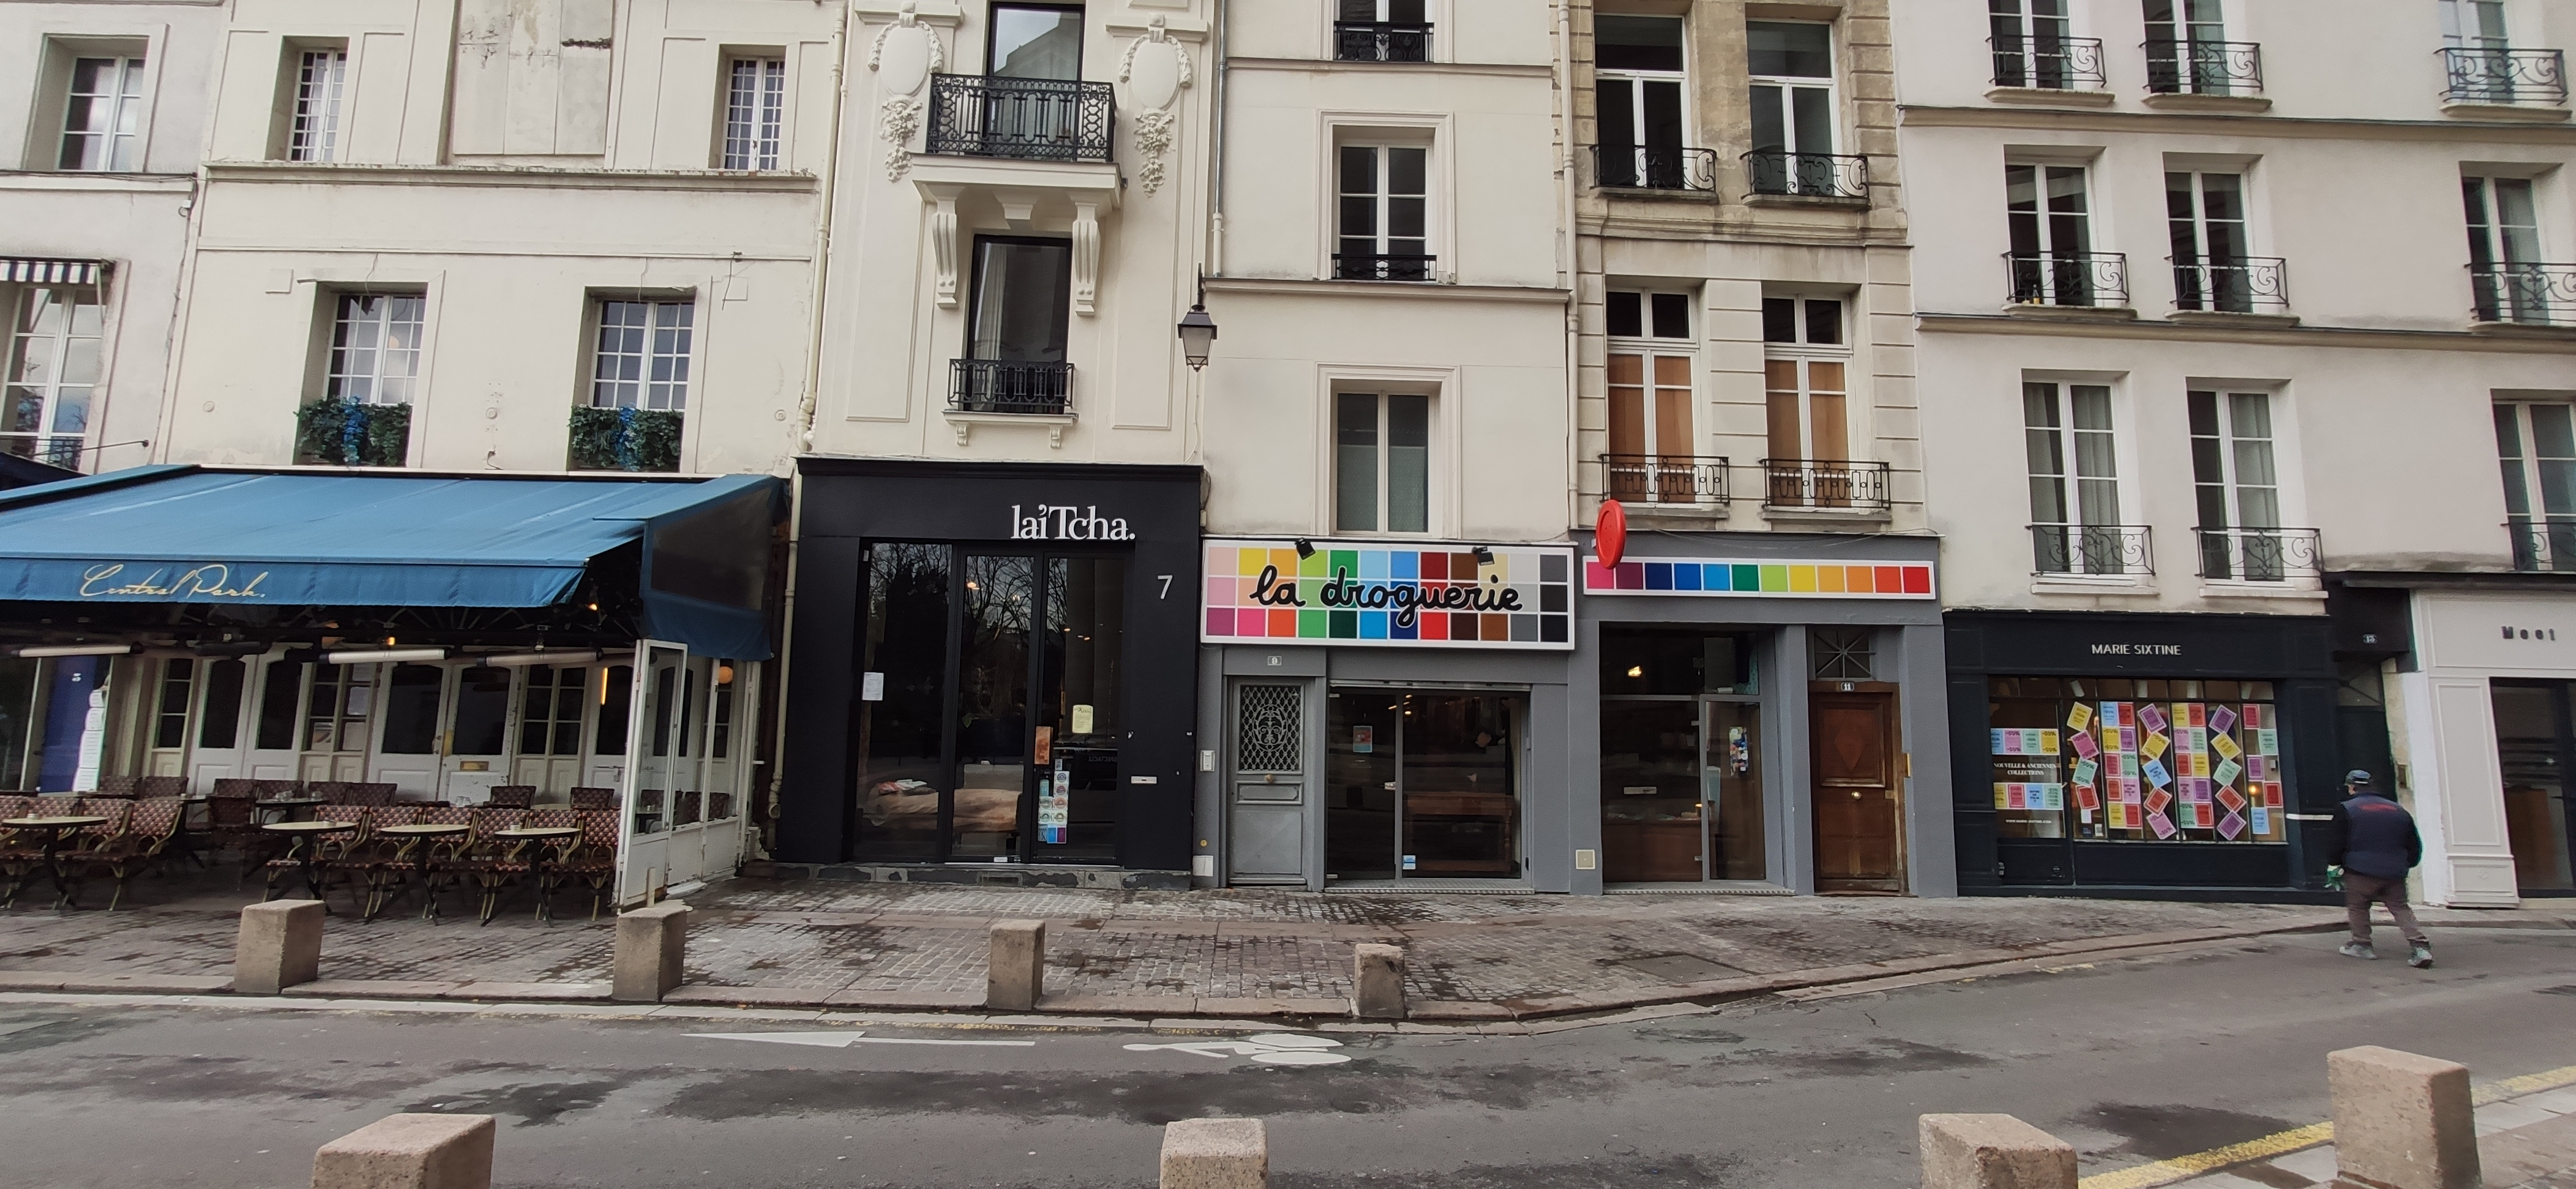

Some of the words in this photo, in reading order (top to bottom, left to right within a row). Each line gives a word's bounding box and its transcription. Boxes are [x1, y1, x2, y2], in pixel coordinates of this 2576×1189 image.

[80, 564, 197, 596] Central
[1157, 574, 1173, 599] 7
[1249, 564, 1306, 607] la
[1319, 565, 1524, 628] droguerie
[2091, 644, 2131, 655] MARIE
[2133, 645, 2182, 655] SIXTINE
